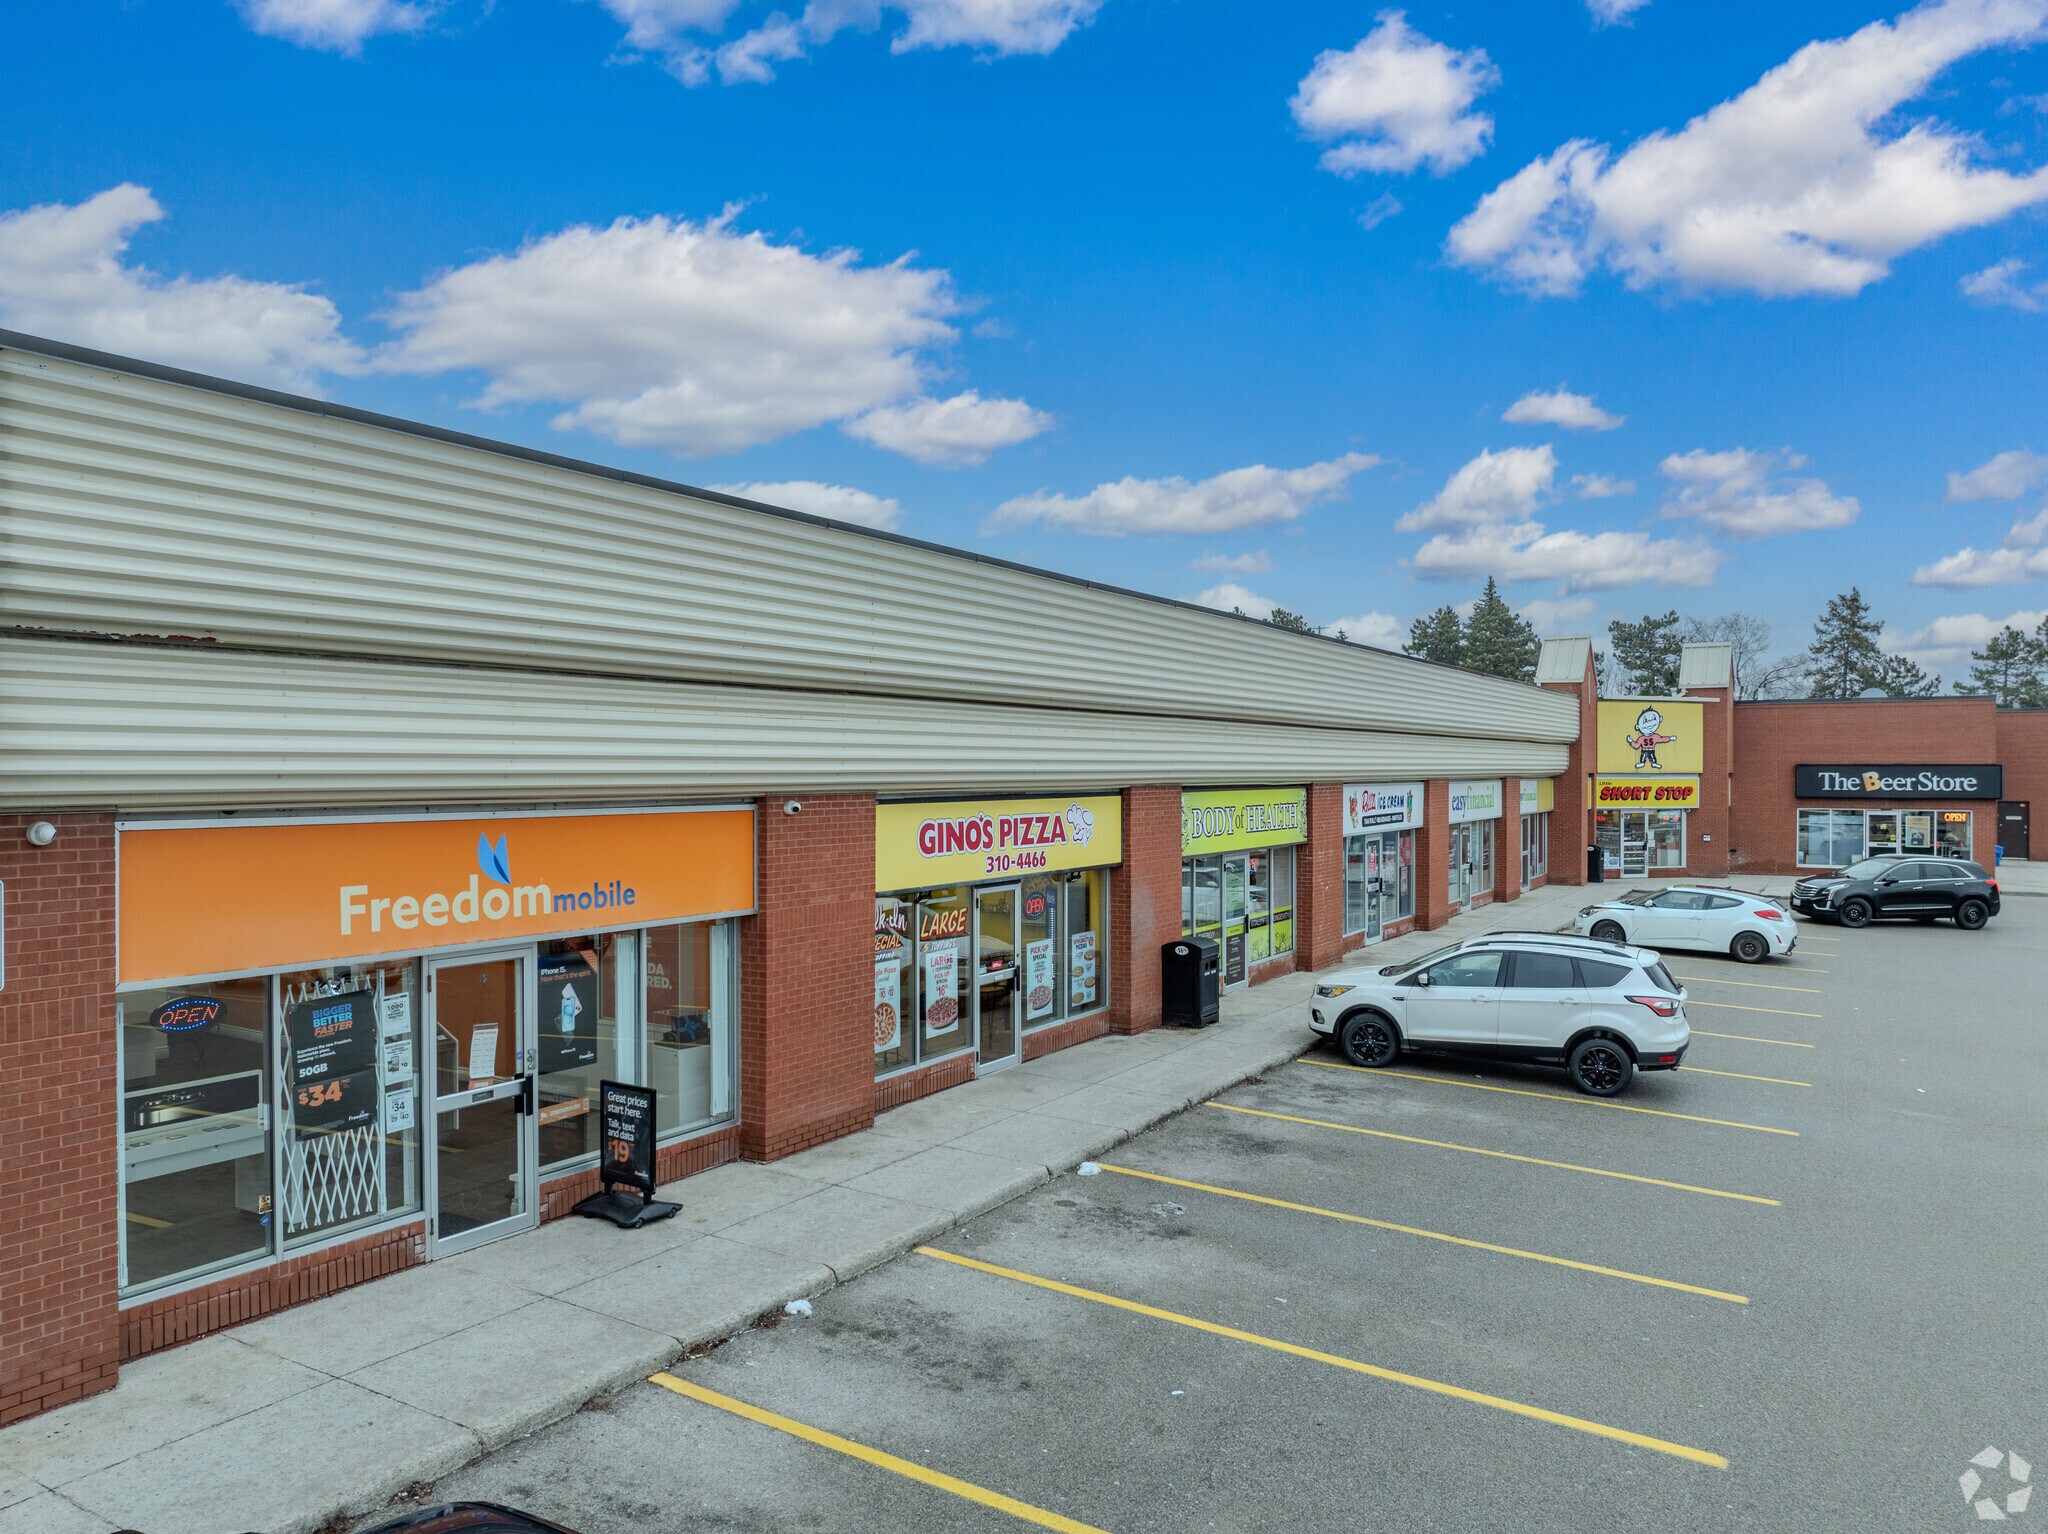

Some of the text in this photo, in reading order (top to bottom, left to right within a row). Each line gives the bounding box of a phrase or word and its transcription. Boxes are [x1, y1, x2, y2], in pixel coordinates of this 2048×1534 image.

[1643, 738, 1654, 746] SS
[1818, 771, 1977, 792] The Beer Store
[1600, 786, 1693, 801] SHORT STOP
[1192, 802, 1298, 838] BODY of HEALTH
[1943, 812, 1967, 823] OPEN
[918, 812, 1068, 857] GINO'S PIZZA
[986, 850, 1047, 874] 310-4466
[340, 874, 636, 936] Freedom mobile
[1026, 898, 1045, 915] OPEN
[920, 907, 968, 941] LARGE
[875, 934, 902, 951] ECIAL
[1030, 944, 1049, 954] PICK-UP
[930, 954, 954, 968] LARGE
[1032, 953, 1047, 961] SPECIAL
[540, 968, 559, 976] iPhone
[160, 1005, 219, 1025] OPEN
[313, 1003, 352, 1019] BIGGER
[313, 1012, 353, 1028] BETTER
[314, 1020, 353, 1037] FASTER
[299, 1062, 328, 1078] 50GB
[298, 1080, 342, 1108] $34
[607, 1091, 648, 1108] Great prices
[348, 1112, 369, 1121] Freedom
[607, 1103, 642, 1118] start here.
[607, 1118, 636, 1133] Talk, text
[607, 1129, 635, 1142] and data
[607, 1140, 630, 1163] $19
